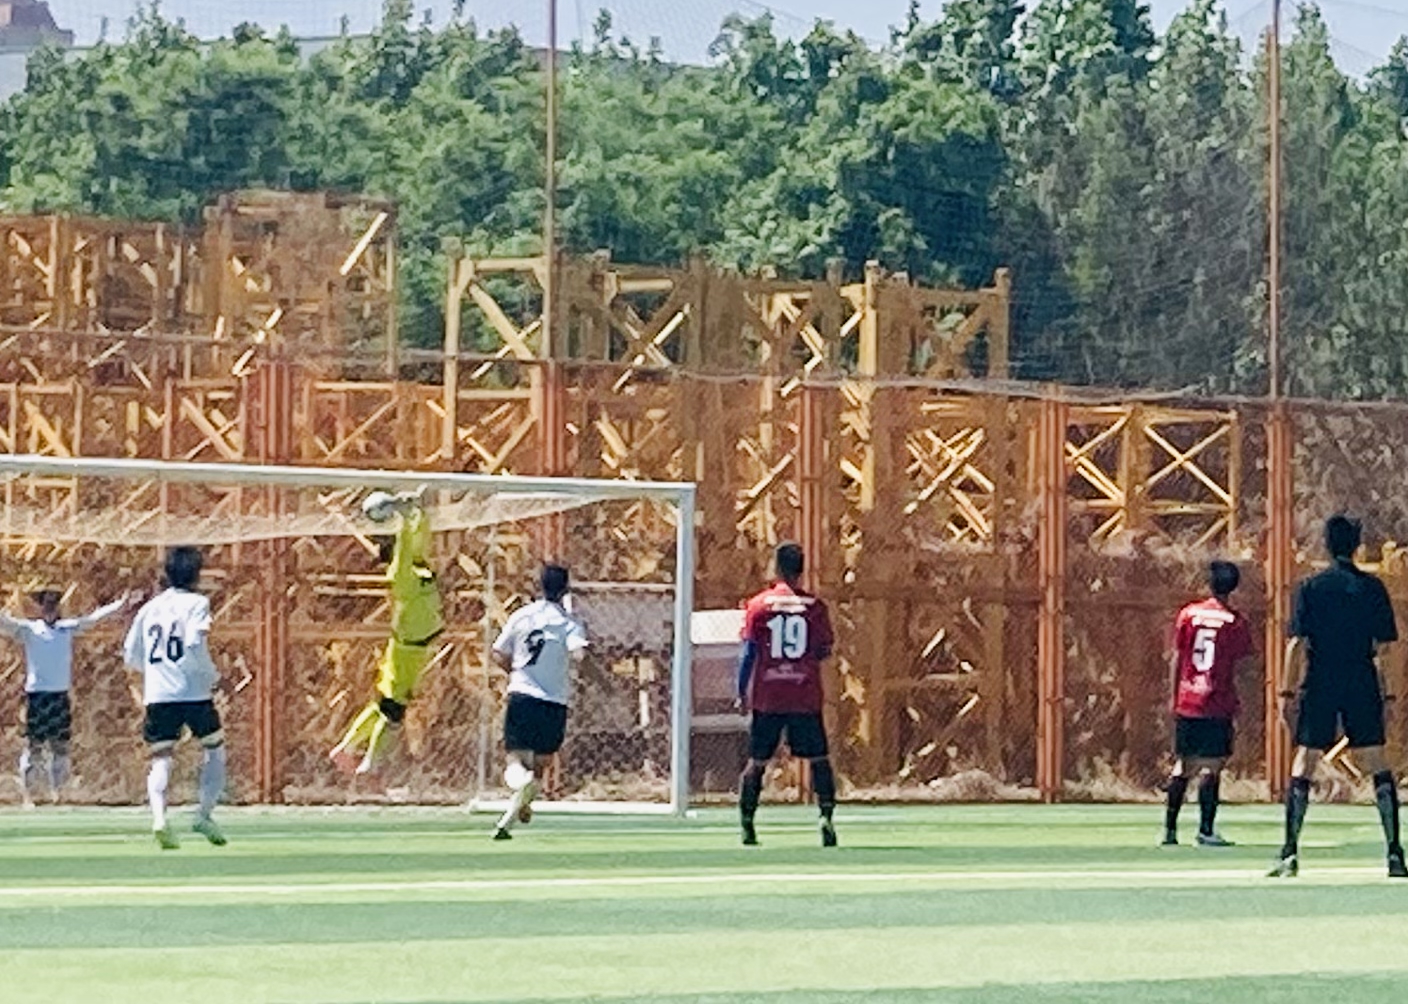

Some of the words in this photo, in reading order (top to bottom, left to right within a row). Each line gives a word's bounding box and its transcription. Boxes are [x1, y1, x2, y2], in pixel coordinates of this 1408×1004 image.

[148, 620, 184, 664] 26
[766, 614, 808, 659] 19
[1192, 628, 1217, 672] 5
